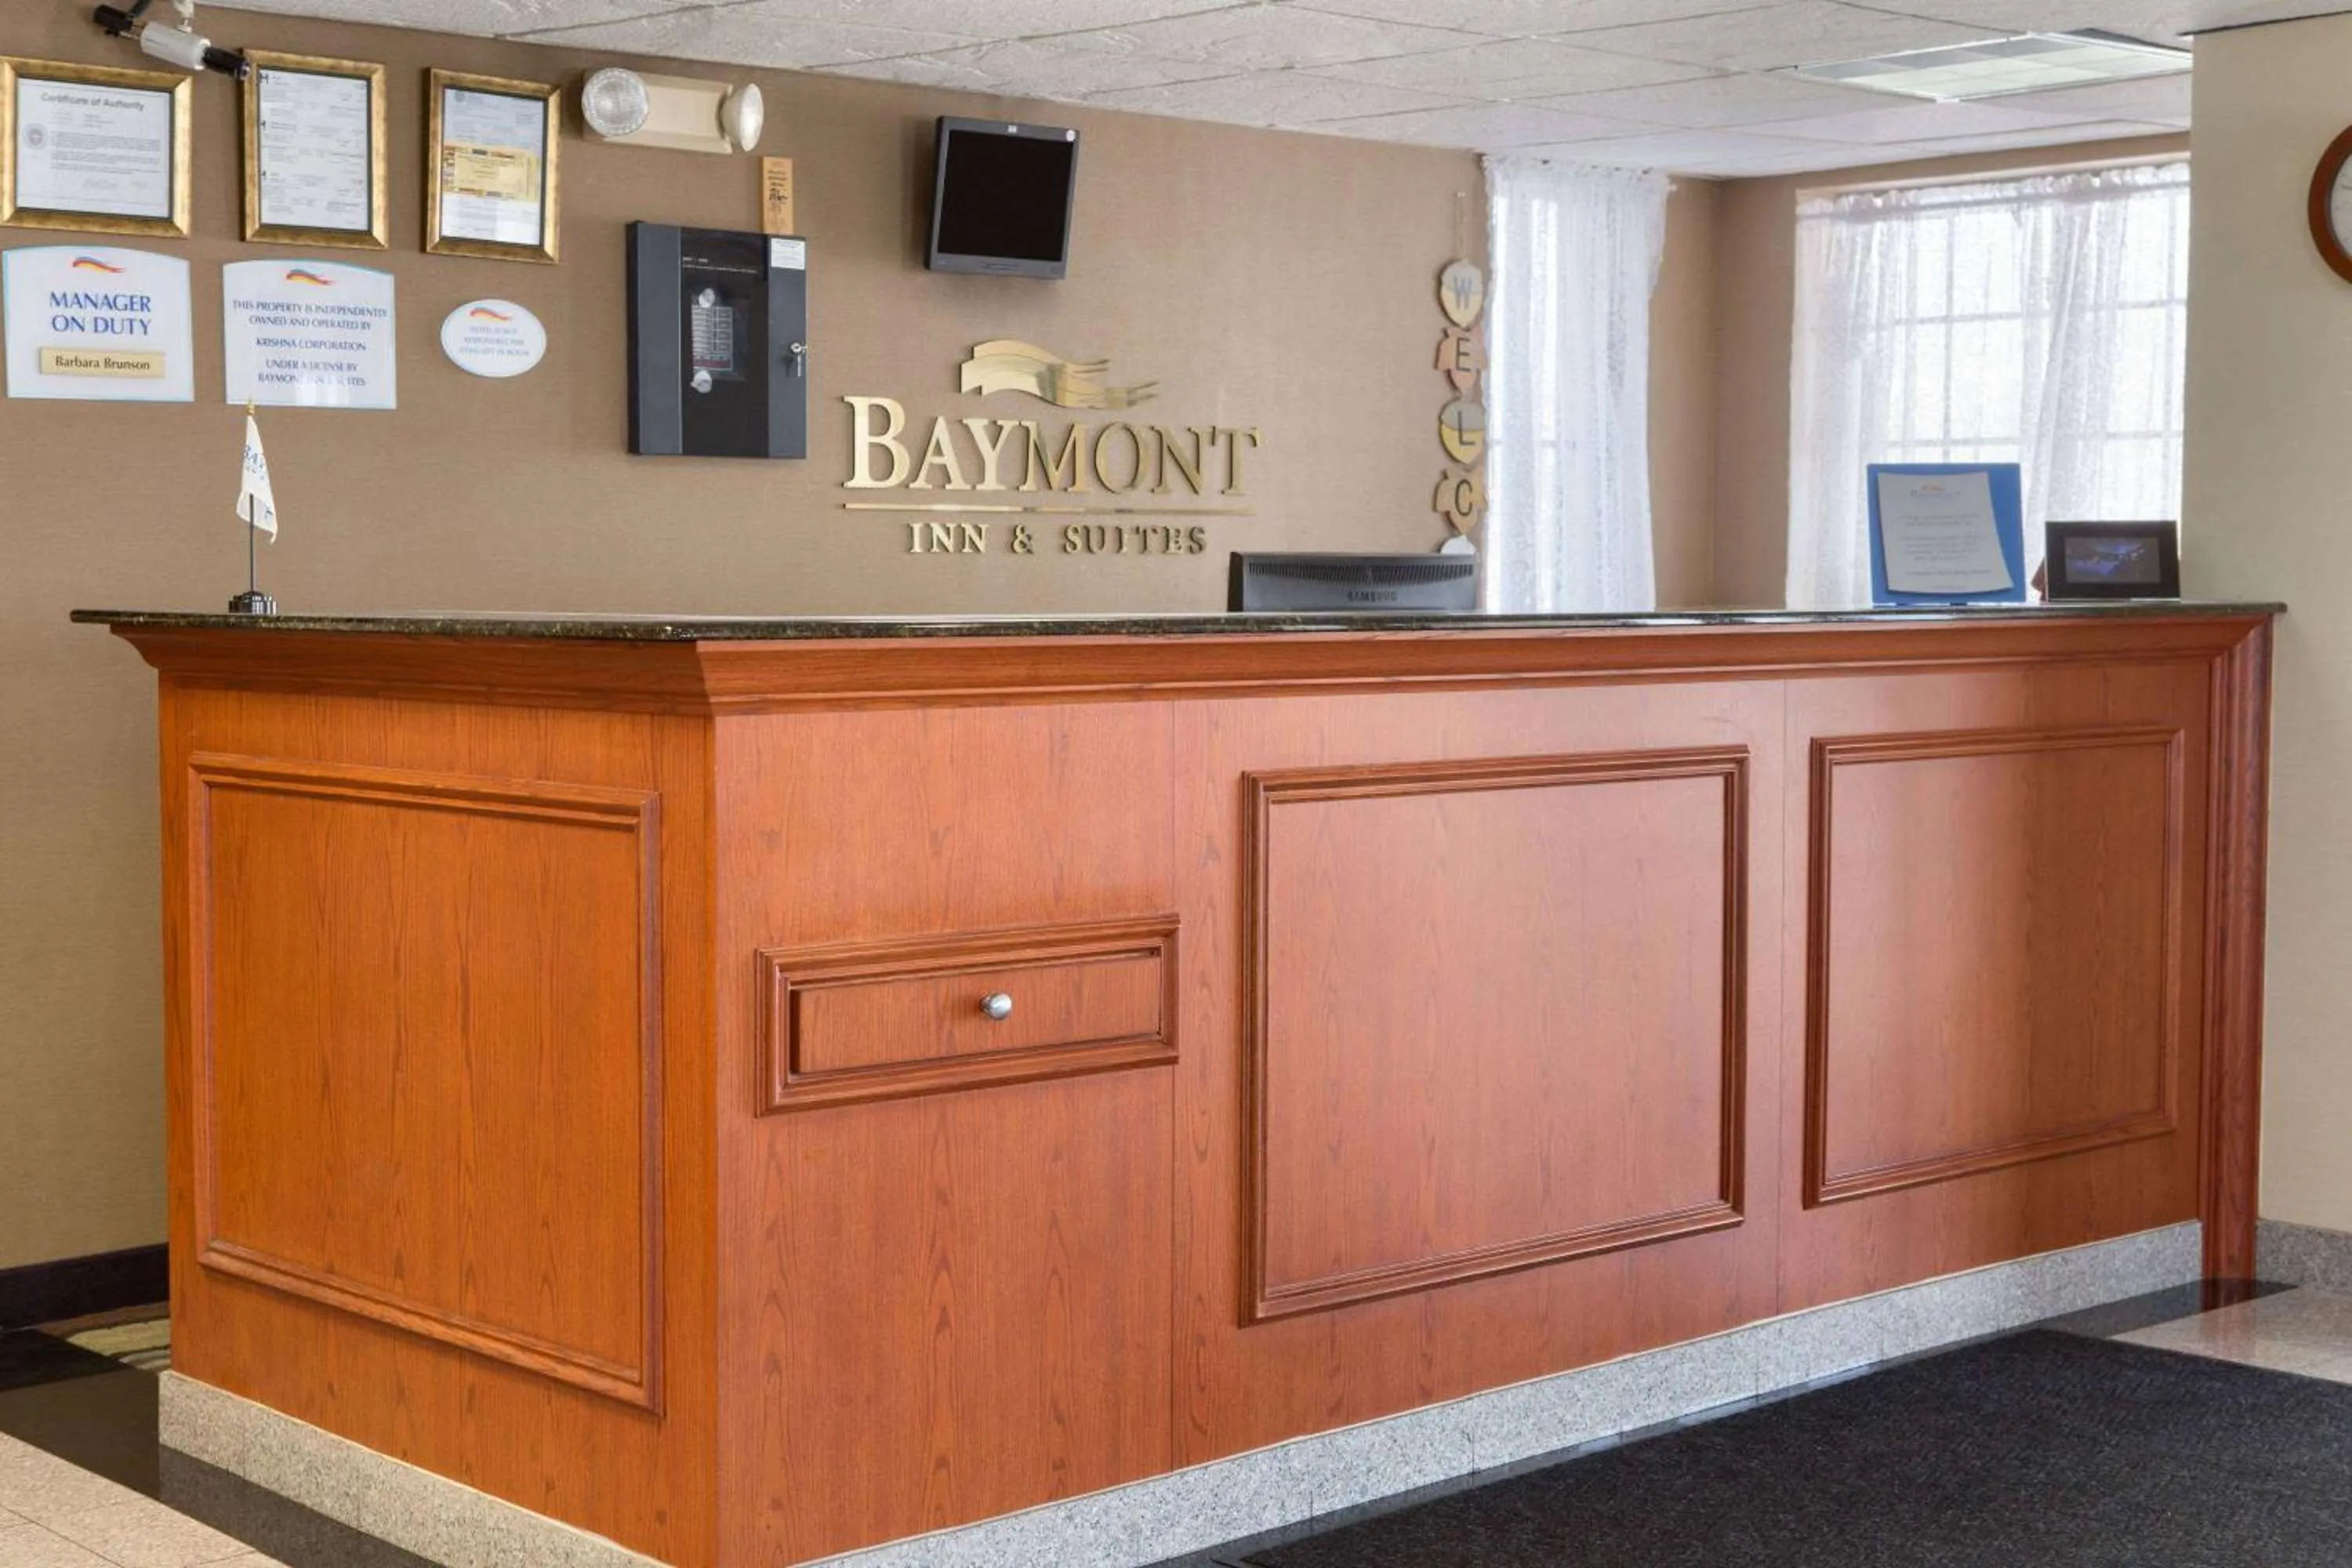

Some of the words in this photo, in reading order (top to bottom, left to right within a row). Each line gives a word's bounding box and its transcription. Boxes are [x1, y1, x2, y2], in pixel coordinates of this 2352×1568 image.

[42, 92, 89, 105] Certificate
[103, 98, 144, 111] Authority
[49, 291, 151, 313] MANAGER
[233, 299, 253, 310] THIS
[256, 301, 302, 313] PROPERTY
[305, 303, 314, 314] IS
[315, 304, 387, 317] INDEPENDENTLY
[52, 314, 85, 333] ON
[93, 316, 151, 336] DUTY
[249, 315, 287, 326] OWNED
[289, 318, 310, 327] AND
[311, 318, 358, 329] OPERATED
[361, 321, 372, 330] BY
[256, 338, 296, 348] KRISHNA
[299, 339, 366, 351] CORPORATION
[55, 354, 100, 368] Barbara
[103, 357, 151, 371] Brunson
[266, 359, 298, 369] UNDER
[301, 360, 307, 369] A
[310, 361, 344, 372] LICENSE
[347, 362, 358, 372] BY
[257, 372, 302, 384] BAYMON
[843, 395, 1259, 495] BAYMONT
[908, 523, 989, 554] INN
[1011, 524, 1033, 554] &
[1063, 524, 1207, 554] SUITES
